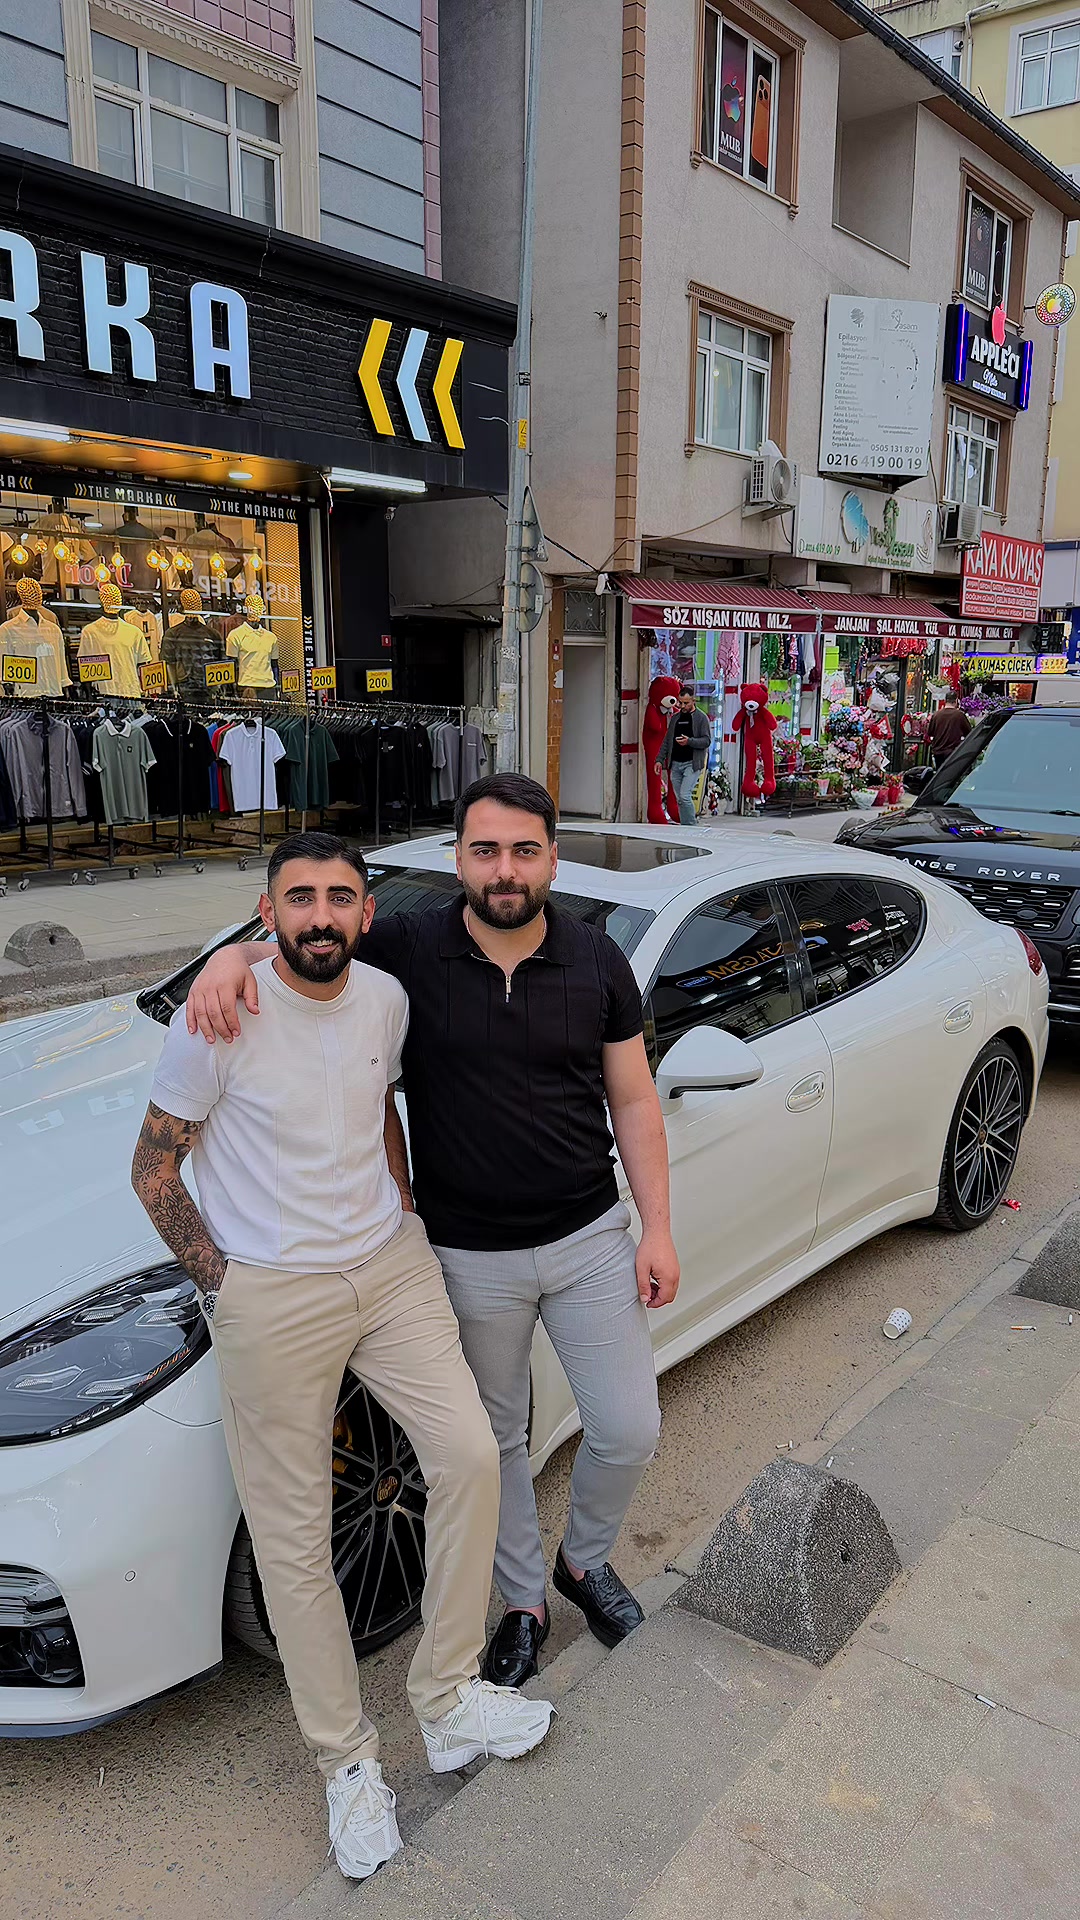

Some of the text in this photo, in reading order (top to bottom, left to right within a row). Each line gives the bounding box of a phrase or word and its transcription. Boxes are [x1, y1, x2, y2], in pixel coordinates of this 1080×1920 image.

[720, 130, 741, 153] MUB
[968, 266, 986, 290] MUB
[870, 443, 924, 454] 0505 131 87 01
[827, 453, 922, 470] 0216 419 00 19
[89, 485, 163, 505] THE MARKA
[221, 500, 285, 520] THE MARKA
[965, 536, 999, 578] KAYA
[663, 606, 792, 630] SÖZ NİŞAN KINA MLZ.
[834, 616, 939, 635] JANJAN ŞAL HAYAL TÜL
[303, 629, 314, 652] THE
[961, 625, 982, 639] KUMAŞ
[985, 626, 1000, 639] KINA
[977, 658, 1006, 674] KUMAŞ
[1007, 658, 1032, 674] ÇİÇEK
[145, 671, 163, 687] 200
[977, 866, 1061, 882] ROVER
[347, 1761, 361, 1777] NIKE
